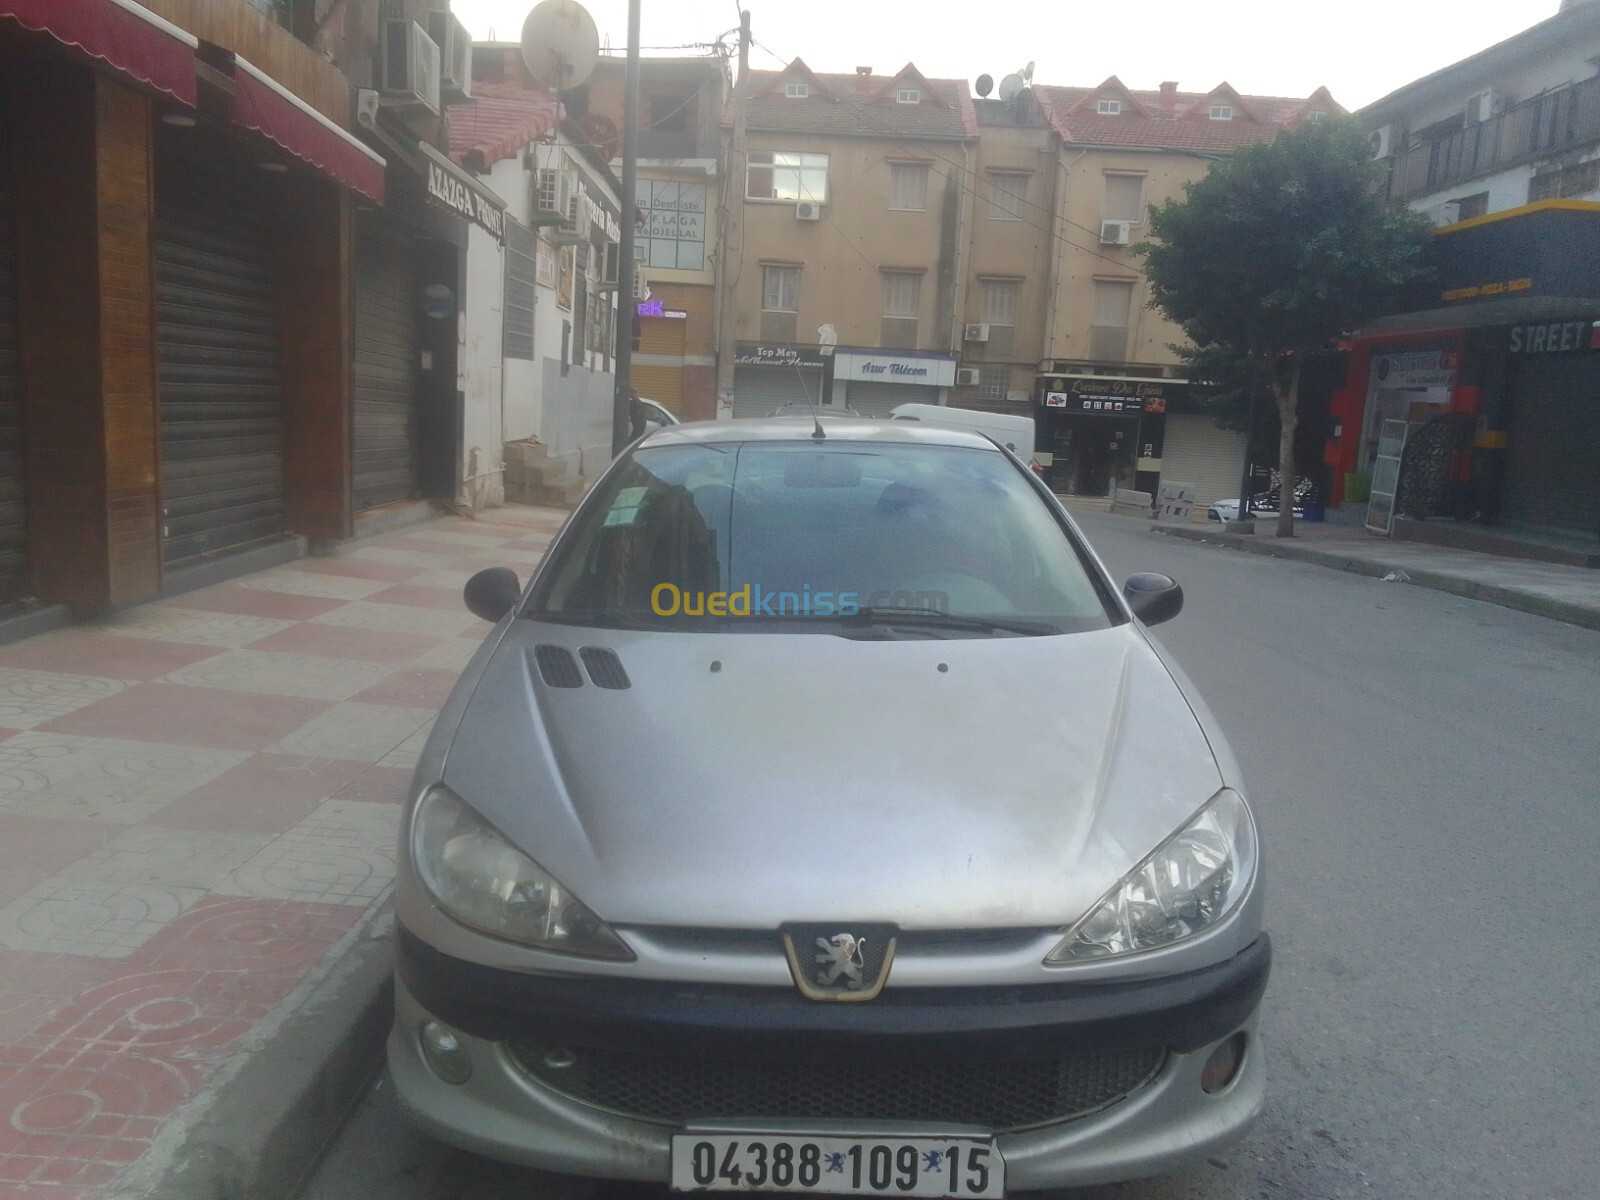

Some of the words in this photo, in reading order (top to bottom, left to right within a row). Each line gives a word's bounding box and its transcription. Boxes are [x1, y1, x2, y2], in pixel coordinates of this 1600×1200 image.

[428, 162, 474, 217] AZAZGA
[1510, 320, 1586, 353] STREET
[733, 354, 785, 367] abillement
[757, 347, 774, 358] Top
[775, 348, 797, 358] Men
[861, 361, 888, 374] Azur
[692, 1141, 821, 1186] 04388
[848, 1144, 919, 1191] 109
[945, 1145, 991, 1194] 15
